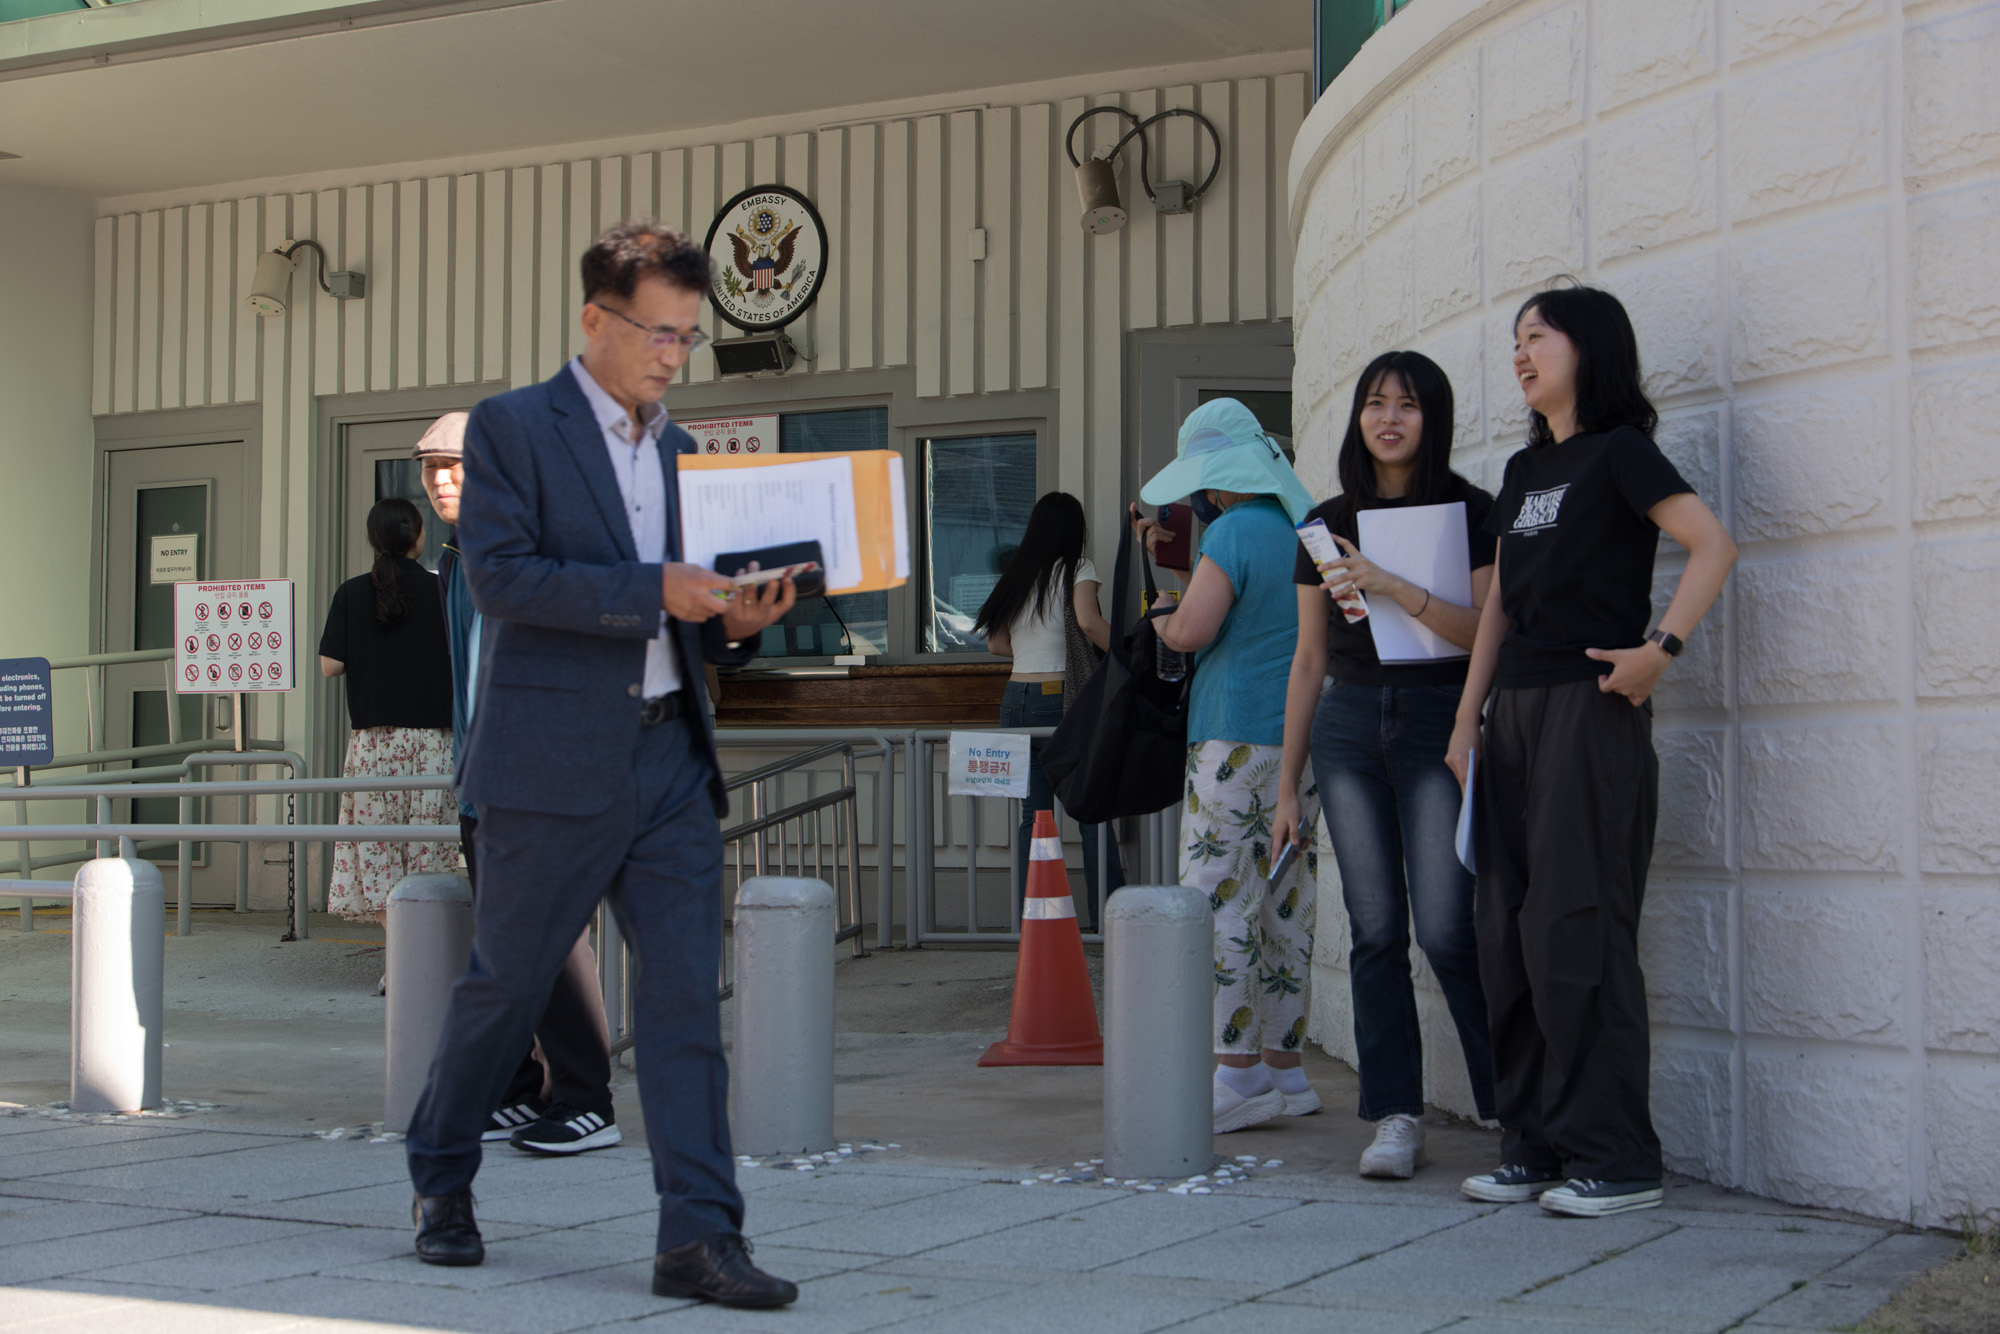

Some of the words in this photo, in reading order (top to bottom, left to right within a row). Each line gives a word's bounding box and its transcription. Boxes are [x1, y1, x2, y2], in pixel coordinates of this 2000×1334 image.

[741, 195, 787, 211] EMBASSY
[713, 279, 736, 312] UNITED
[736, 308, 771, 322] STATES
[772, 307, 785, 319] OF
[787, 269, 816, 311] AMERICA
[688, 422, 730, 431] PROHIBITED
[732, 420, 754, 428] ITEMS
[170, 548, 188, 556] ENTRY
[198, 583, 242, 592] PROHIBITED
[243, 583, 266, 591] ITEMS
[1, 673, 40, 681] electronics,
[19, 683, 44, 692] phones,
[4, 694, 12, 702] be
[14, 693, 35, 701] turned
[37, 692, 46, 700] off
[13, 703, 42, 712] entering.
[968, 747, 982, 757] No
[985, 748, 1011, 760] Entry
[968, 760, 1011, 775] 통행금지
